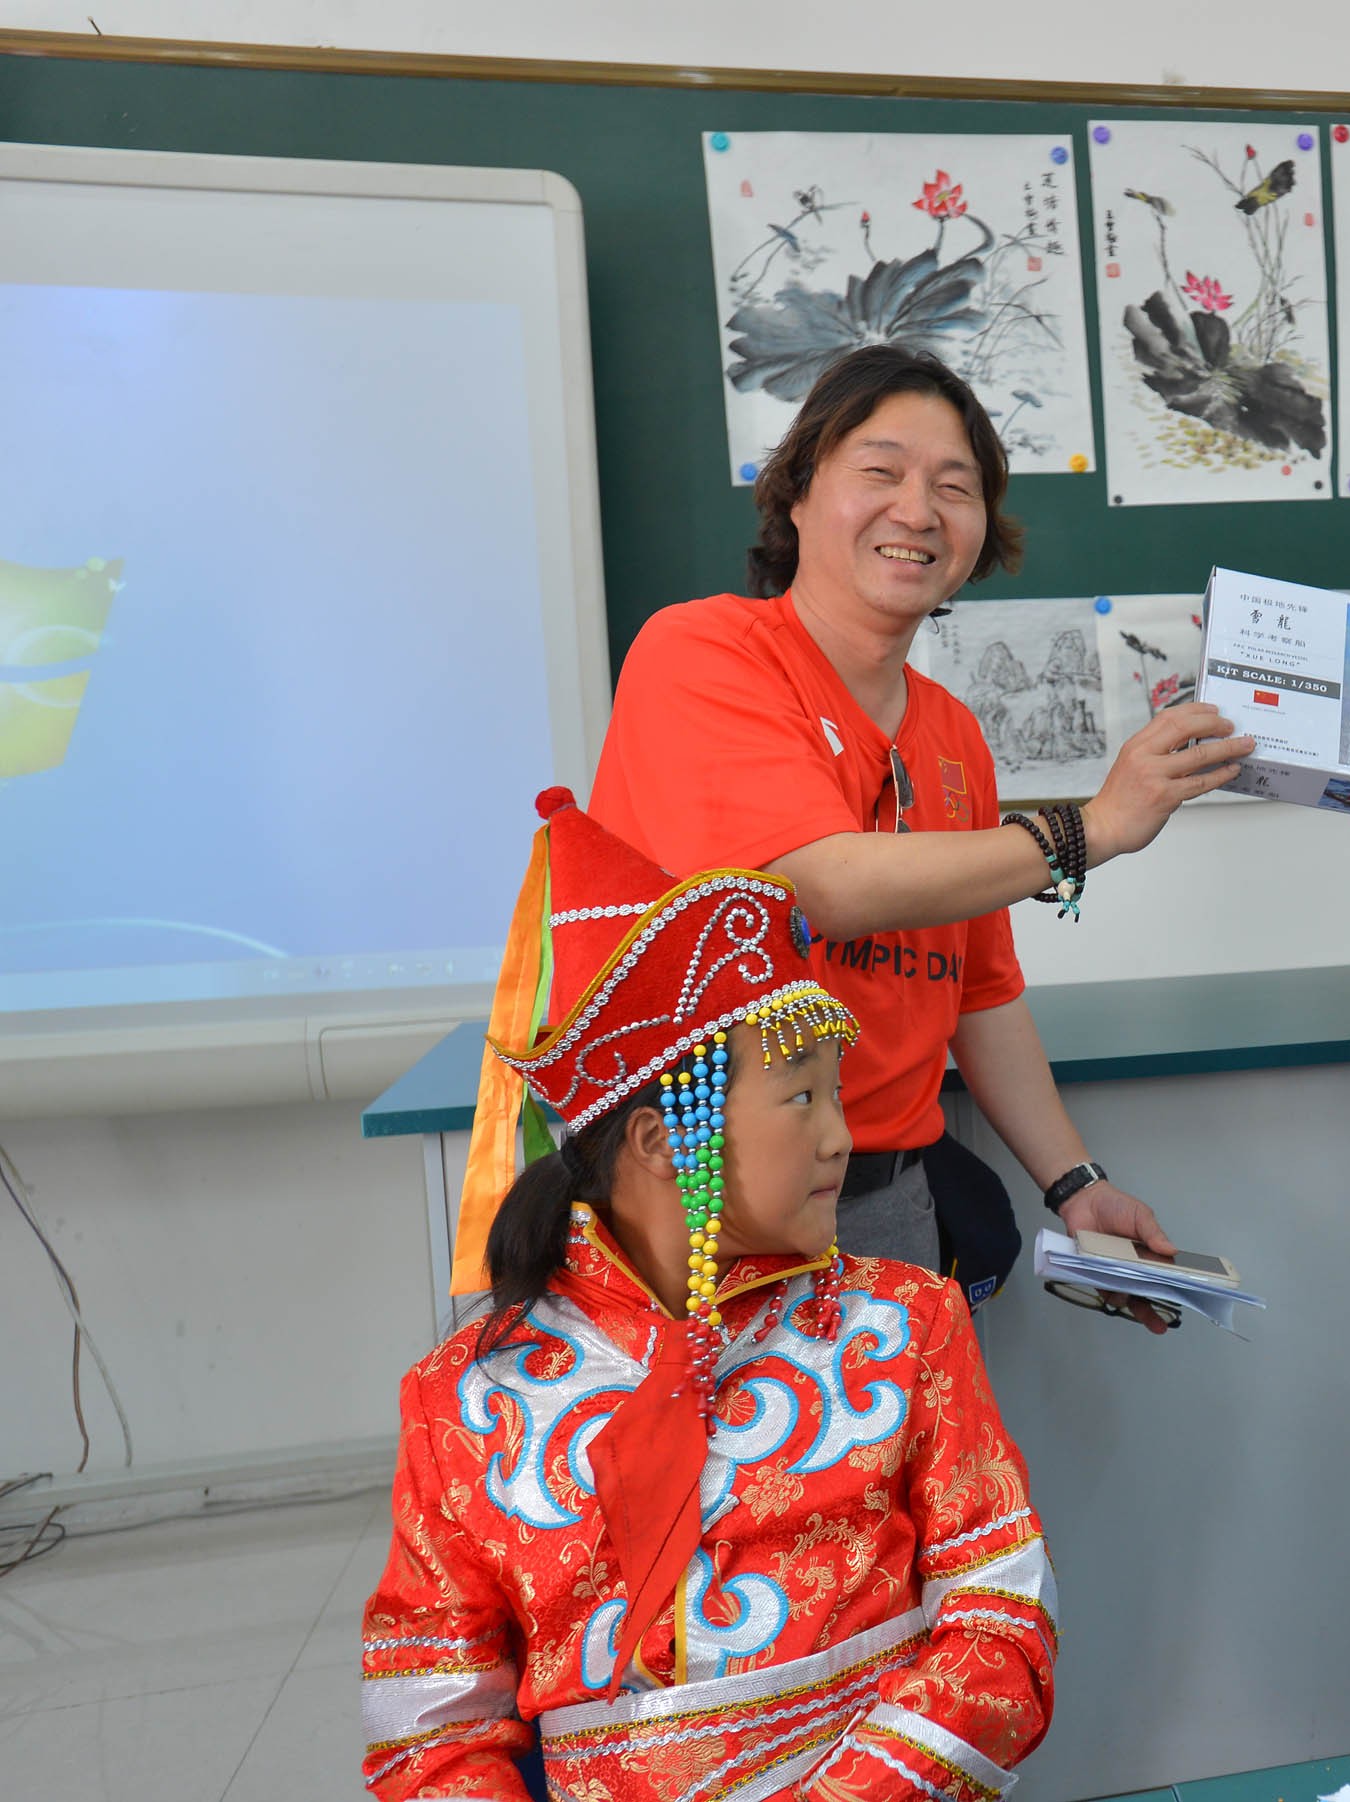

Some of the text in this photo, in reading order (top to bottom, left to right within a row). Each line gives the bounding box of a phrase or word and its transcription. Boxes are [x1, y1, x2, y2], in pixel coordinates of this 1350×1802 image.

[1216, 664, 1328, 693] KIT SCALE: 1/350
[811, 933, 918, 979] YMPIC
